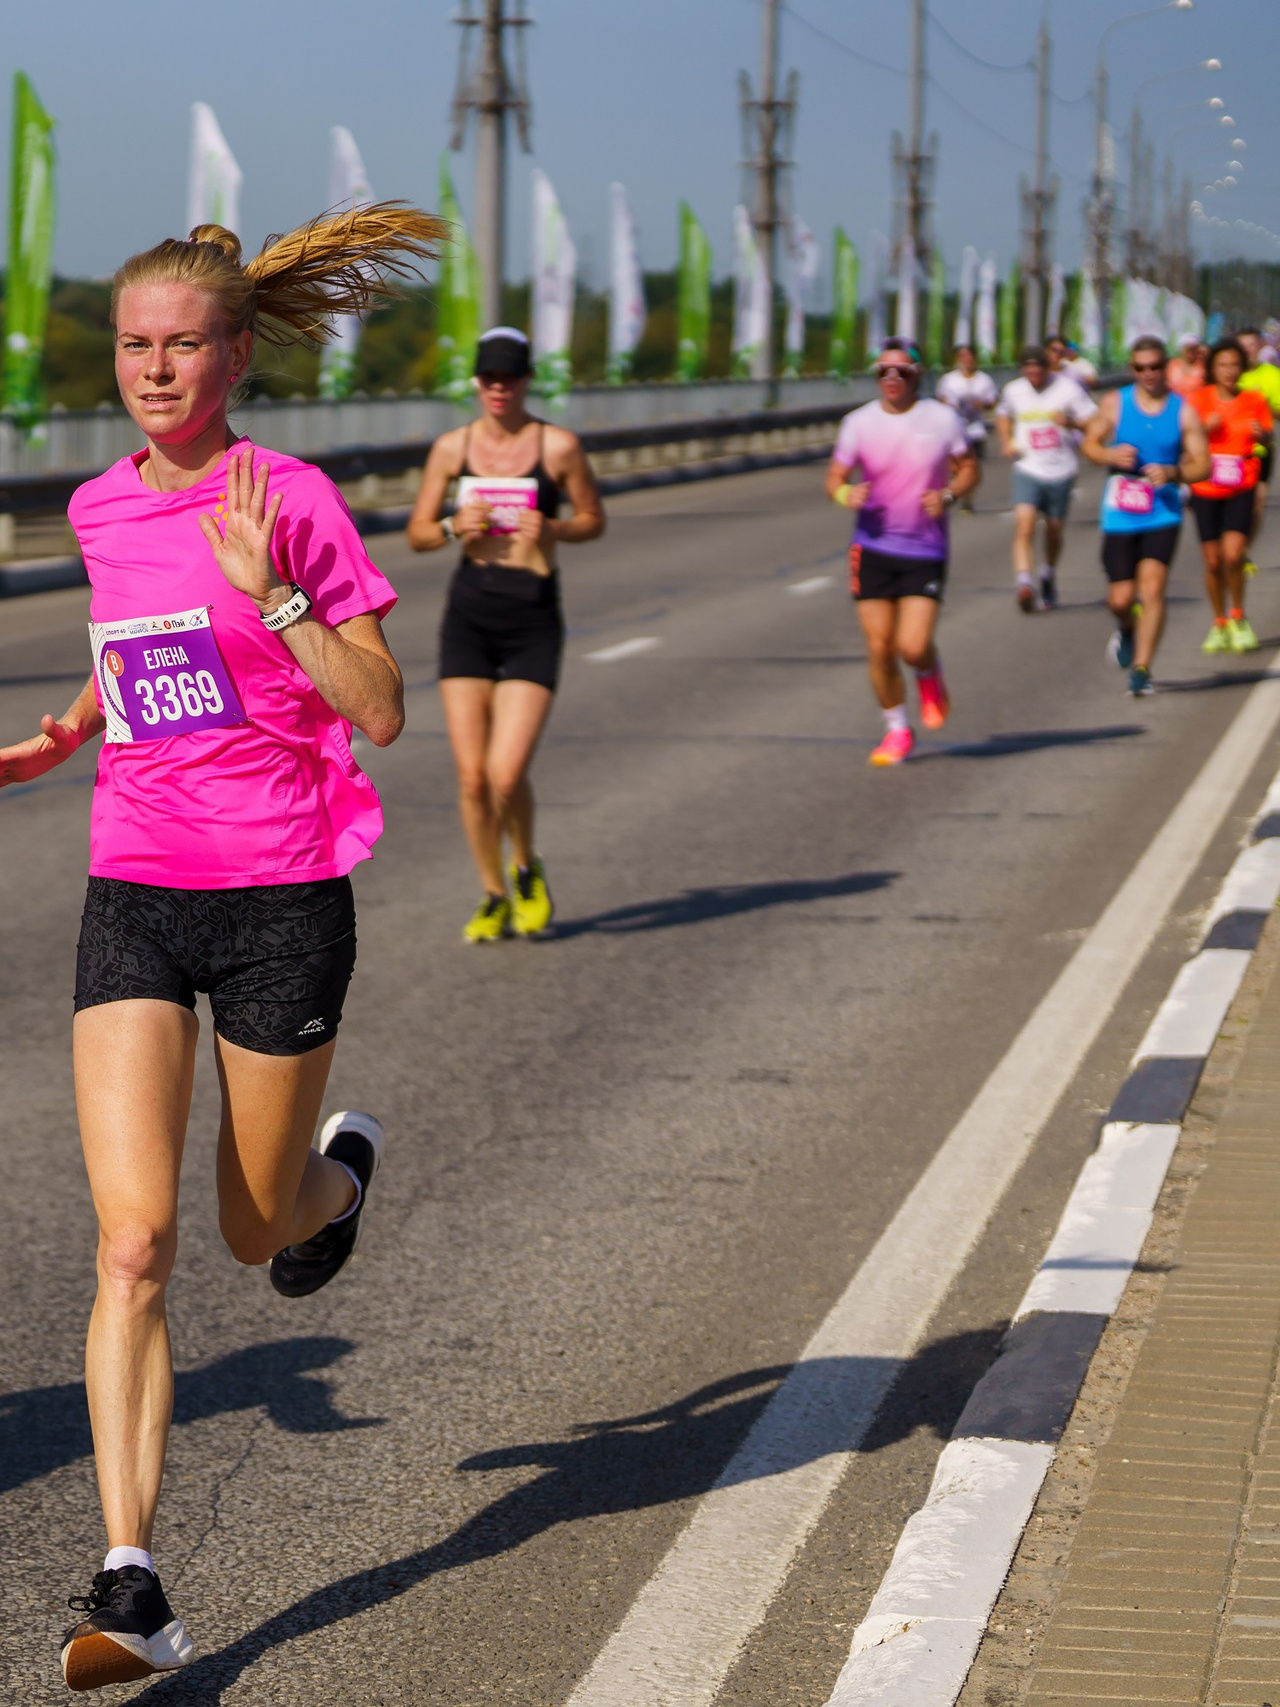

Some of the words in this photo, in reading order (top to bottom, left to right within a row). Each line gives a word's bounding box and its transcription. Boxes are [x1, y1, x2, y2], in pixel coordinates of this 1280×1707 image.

[171, 619, 186, 628] Пэй
[143, 645, 190, 670] ЕЛЕНА
[134, 670, 225, 725] 3369
